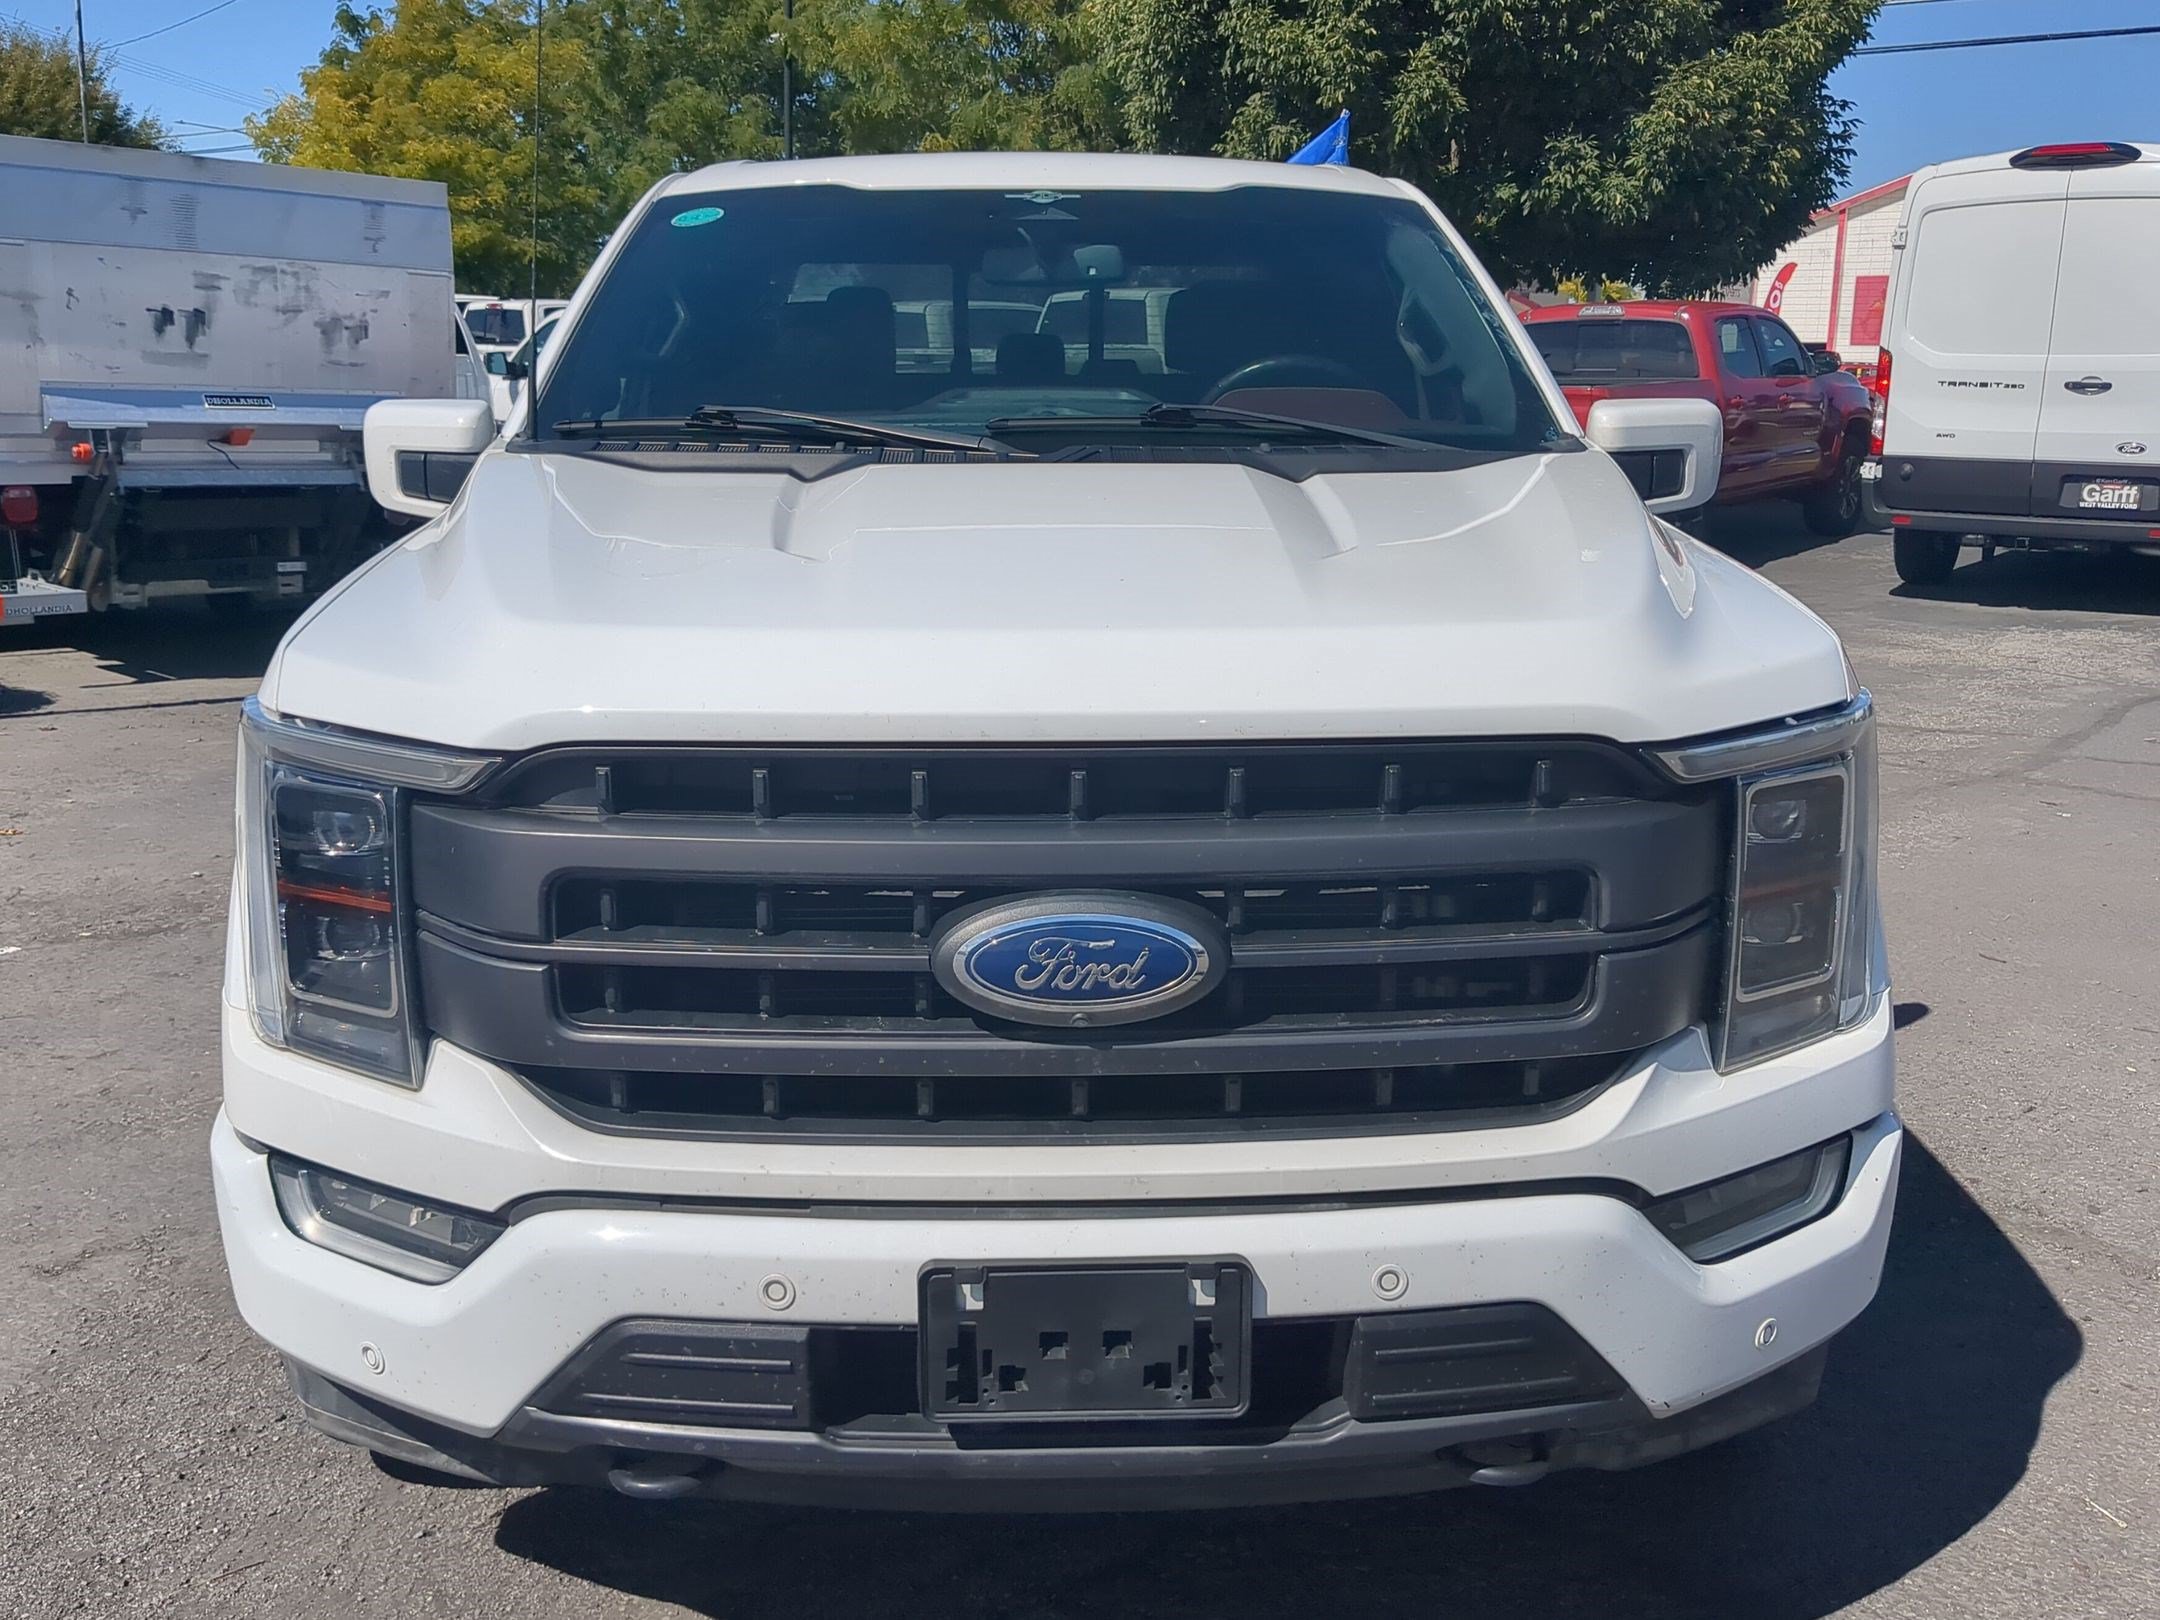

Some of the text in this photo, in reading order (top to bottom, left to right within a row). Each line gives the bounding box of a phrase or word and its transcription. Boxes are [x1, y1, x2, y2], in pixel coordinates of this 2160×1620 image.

[206, 397, 272, 405] DHOLLANDIA
[2082, 484, 2138, 503] Garff
[5, 604, 73, 616] DHOLLANDIA
[1014, 937, 1151, 991] Ford
